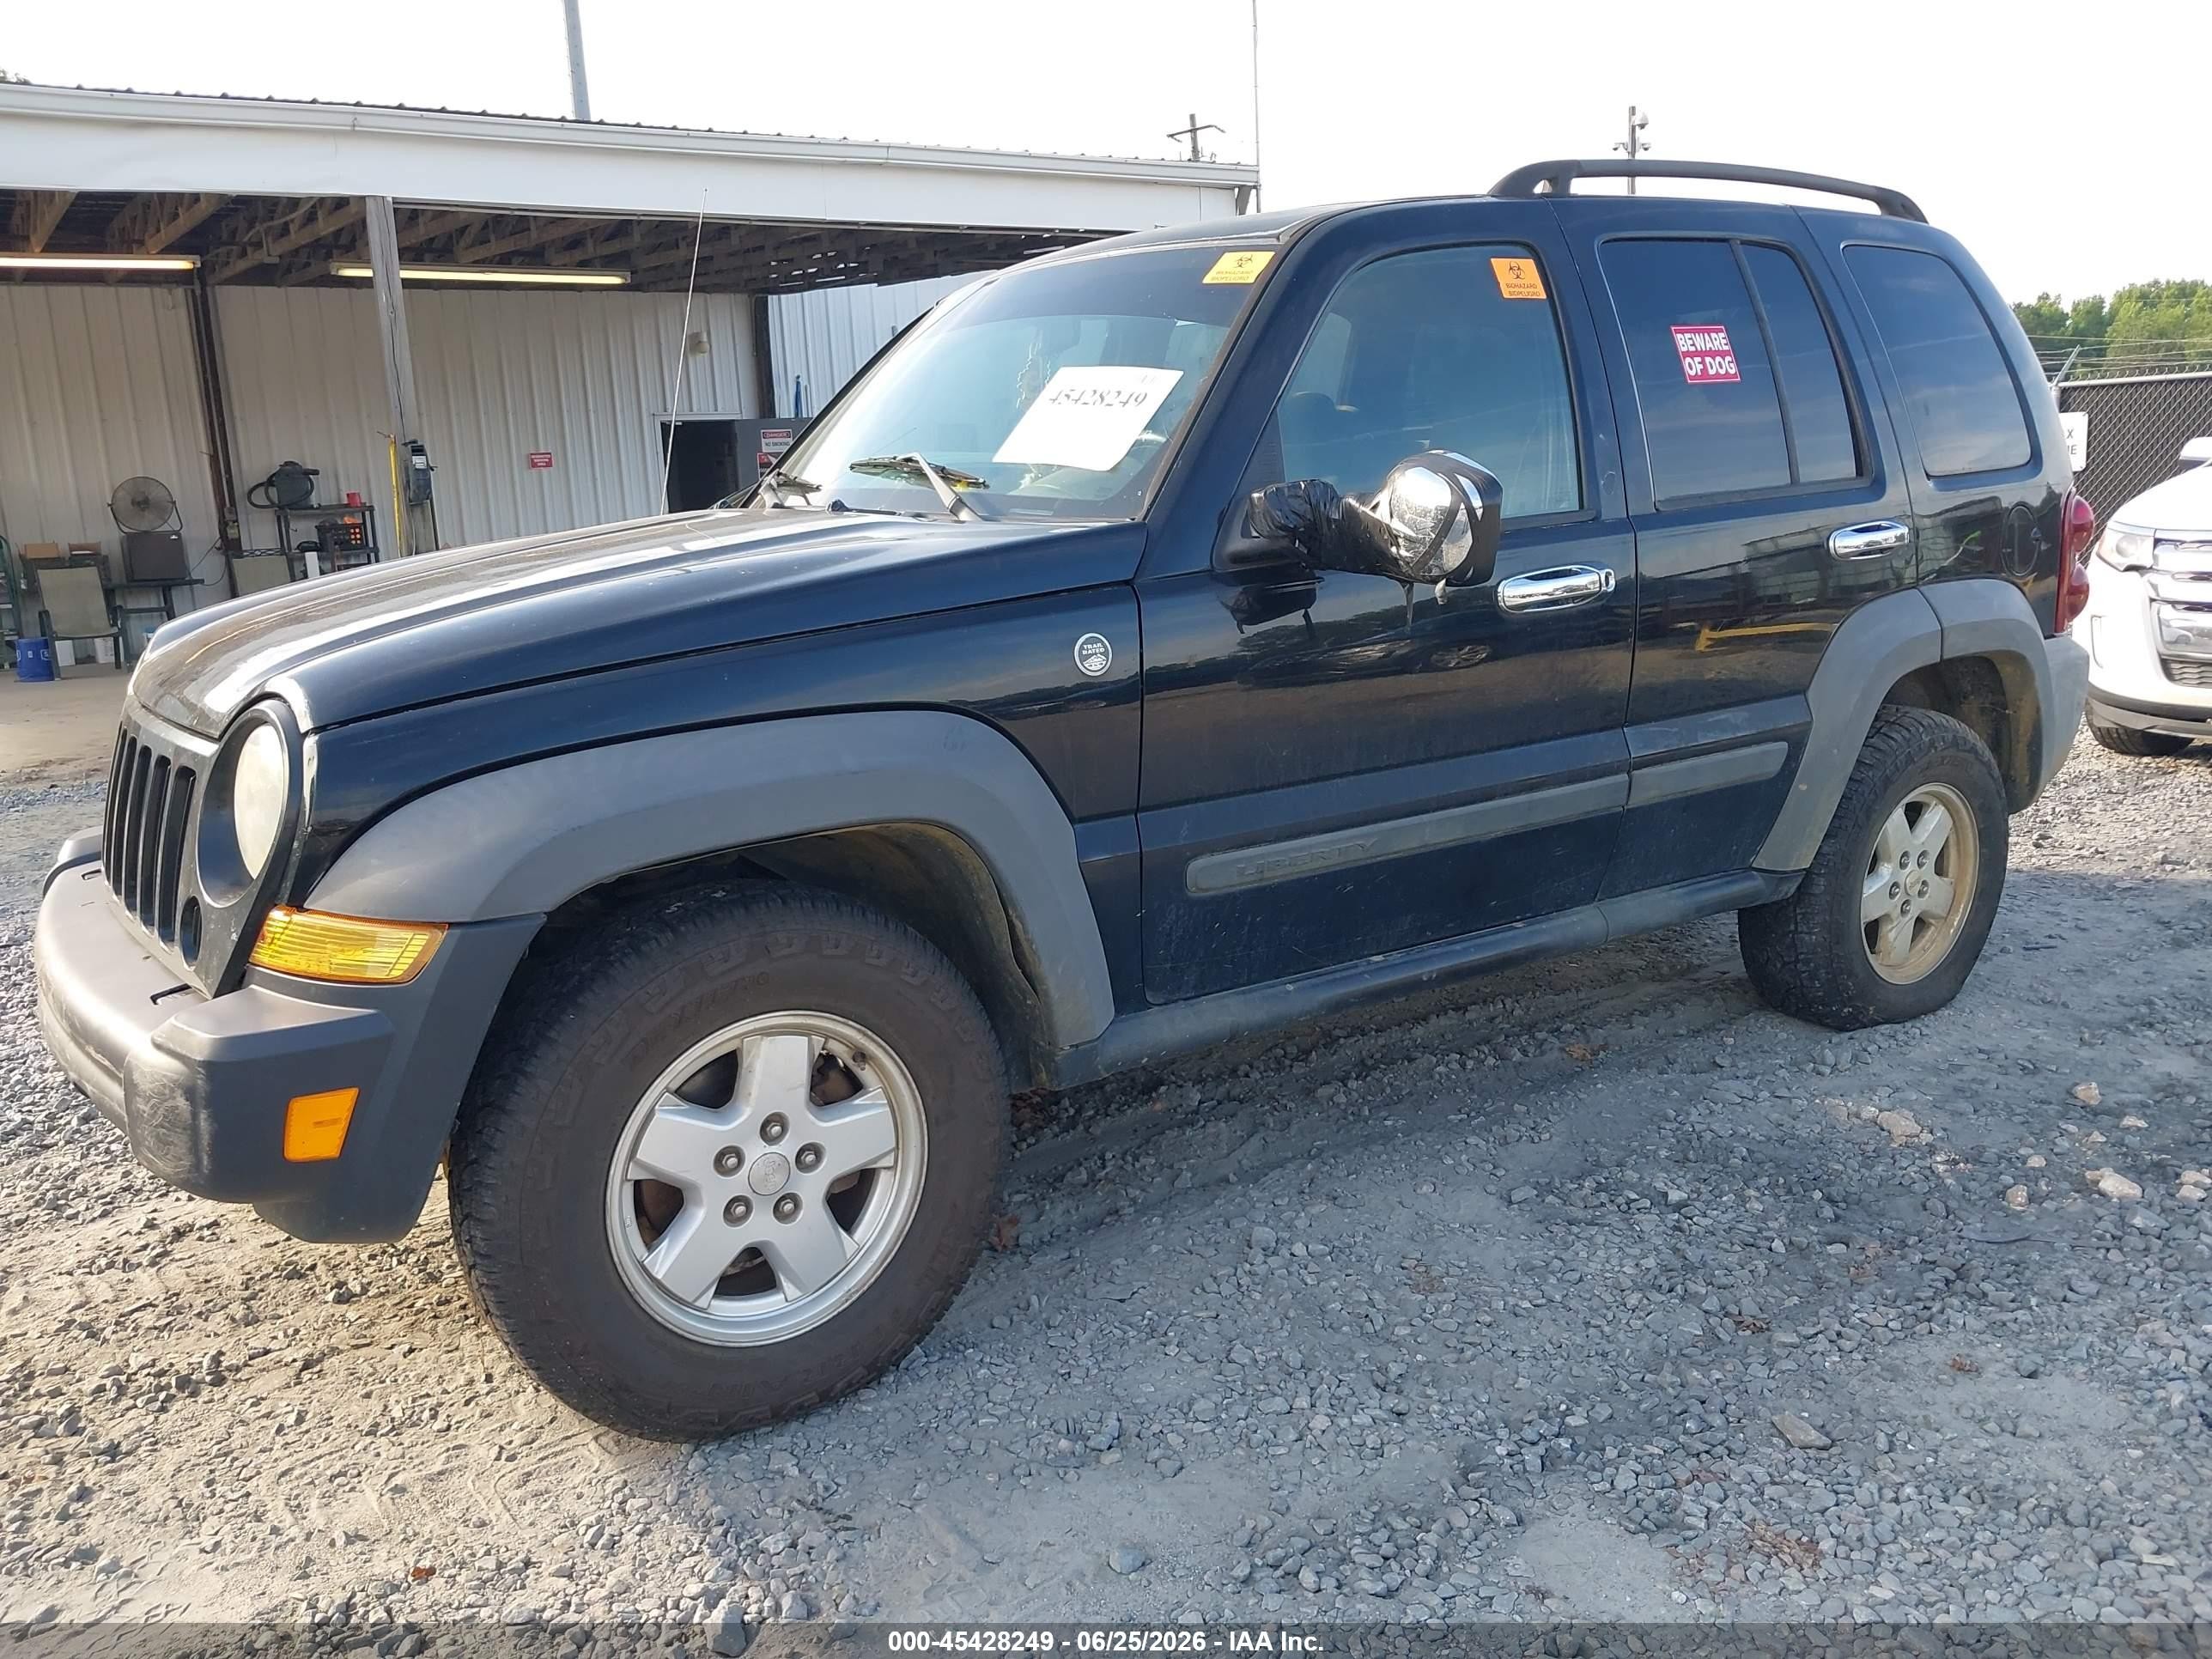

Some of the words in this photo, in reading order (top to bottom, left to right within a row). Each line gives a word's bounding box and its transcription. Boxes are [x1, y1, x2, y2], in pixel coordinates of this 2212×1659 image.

[1676, 332, 1729, 351] BEWARE
[1685, 356, 1704, 375] OF
[1705, 356, 1735, 375] DOG
[1048, 389, 1147, 407] 45428249
